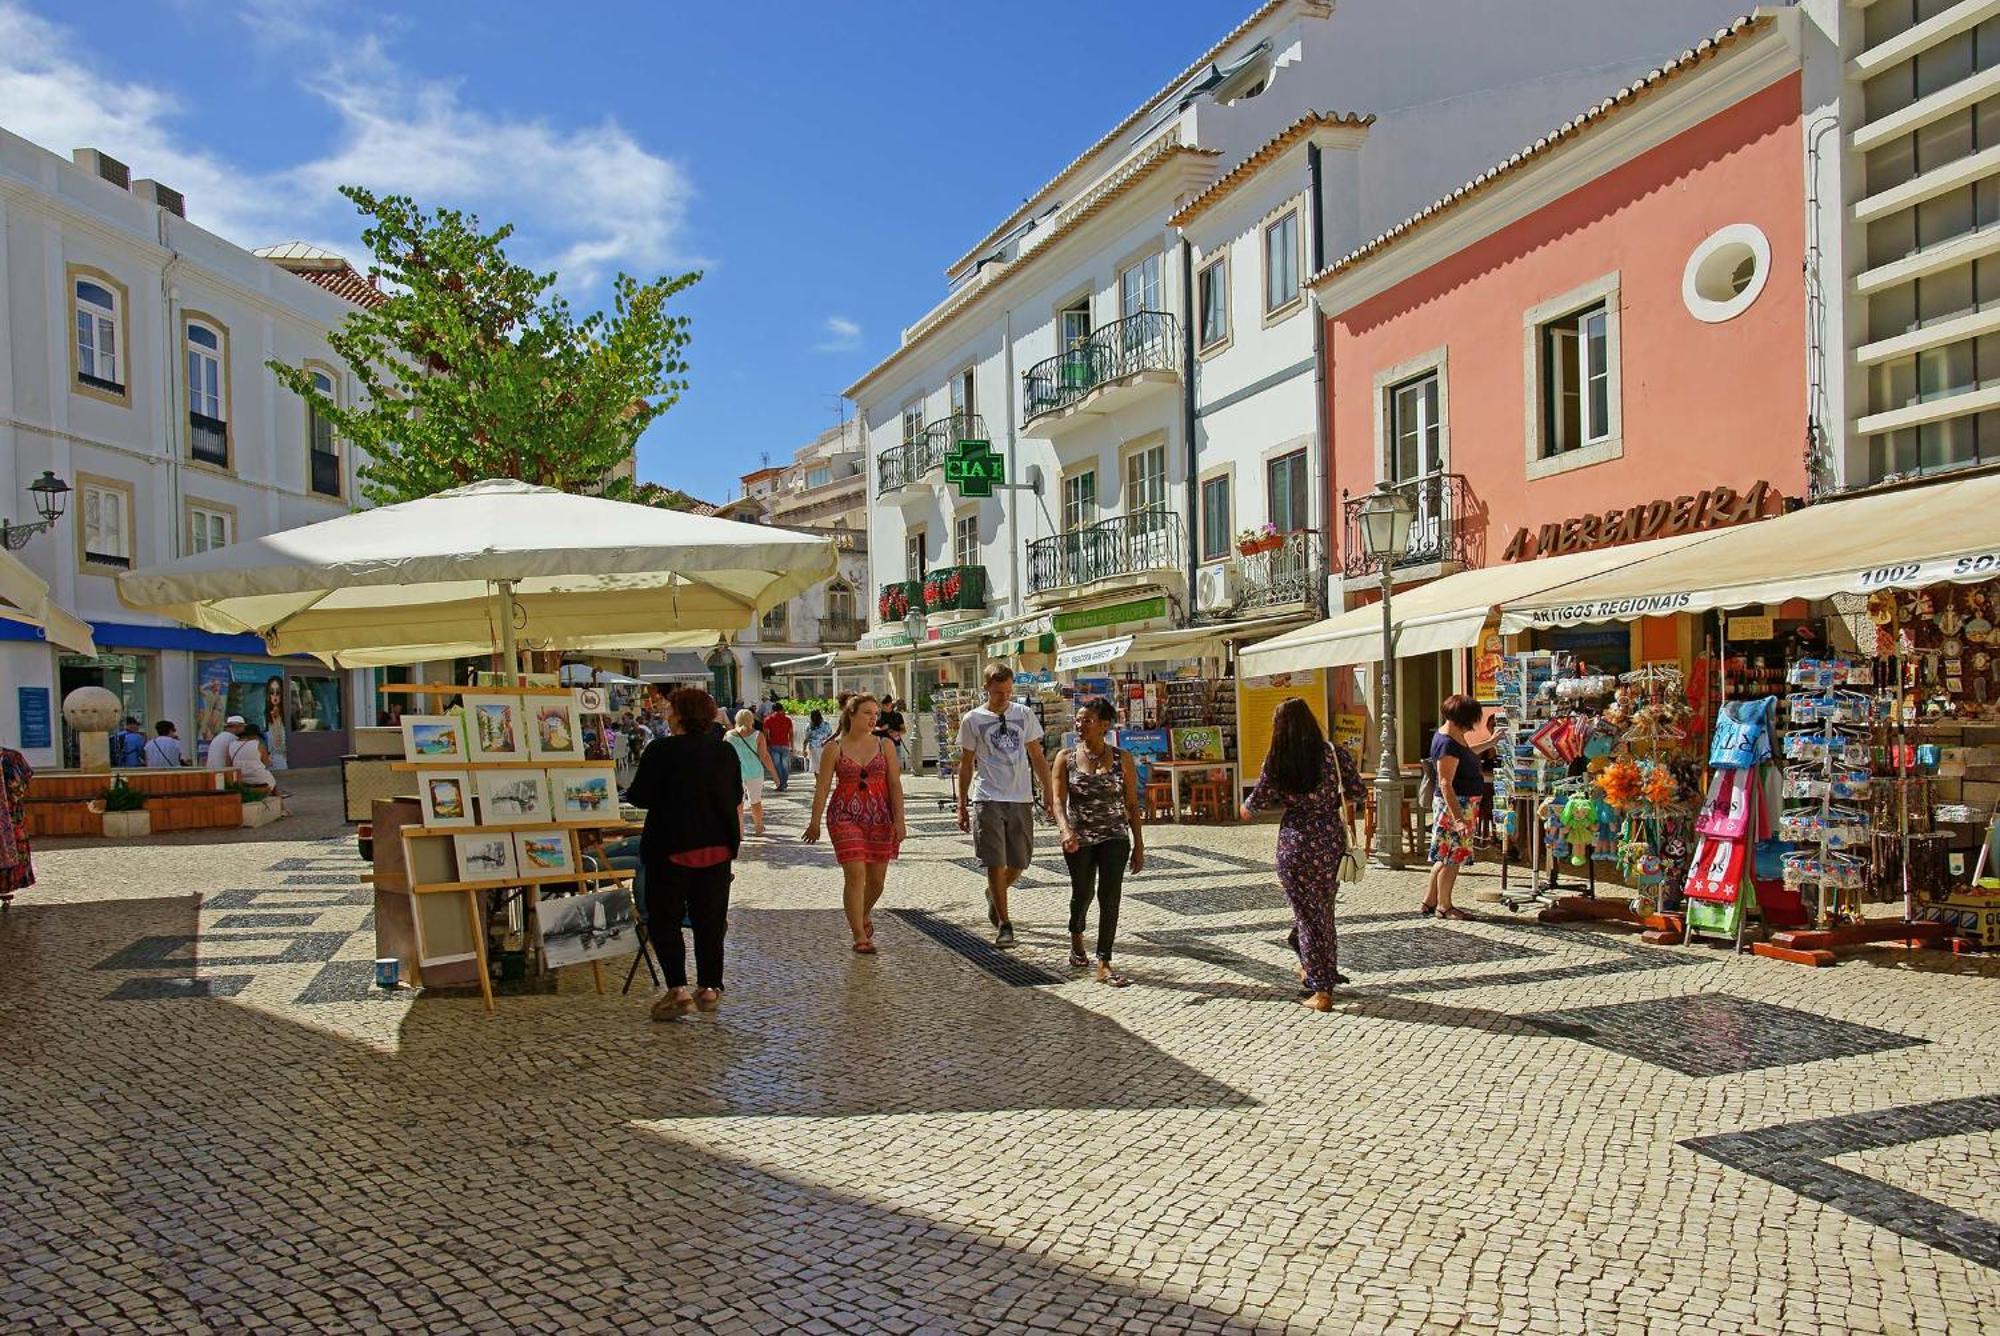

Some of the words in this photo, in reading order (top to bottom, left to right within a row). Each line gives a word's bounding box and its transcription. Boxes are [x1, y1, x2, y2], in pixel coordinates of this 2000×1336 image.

[948, 461, 985, 477] CIA
[1502, 527, 1528, 561] A
[1536, 479, 1769, 555] MERENDEIRA
[1861, 563, 1920, 585] 1002
[1953, 554, 2000, 575] SO
[1532, 604, 1594, 623] ARTIGOS
[1597, 592, 1692, 616] REGIONAIS
